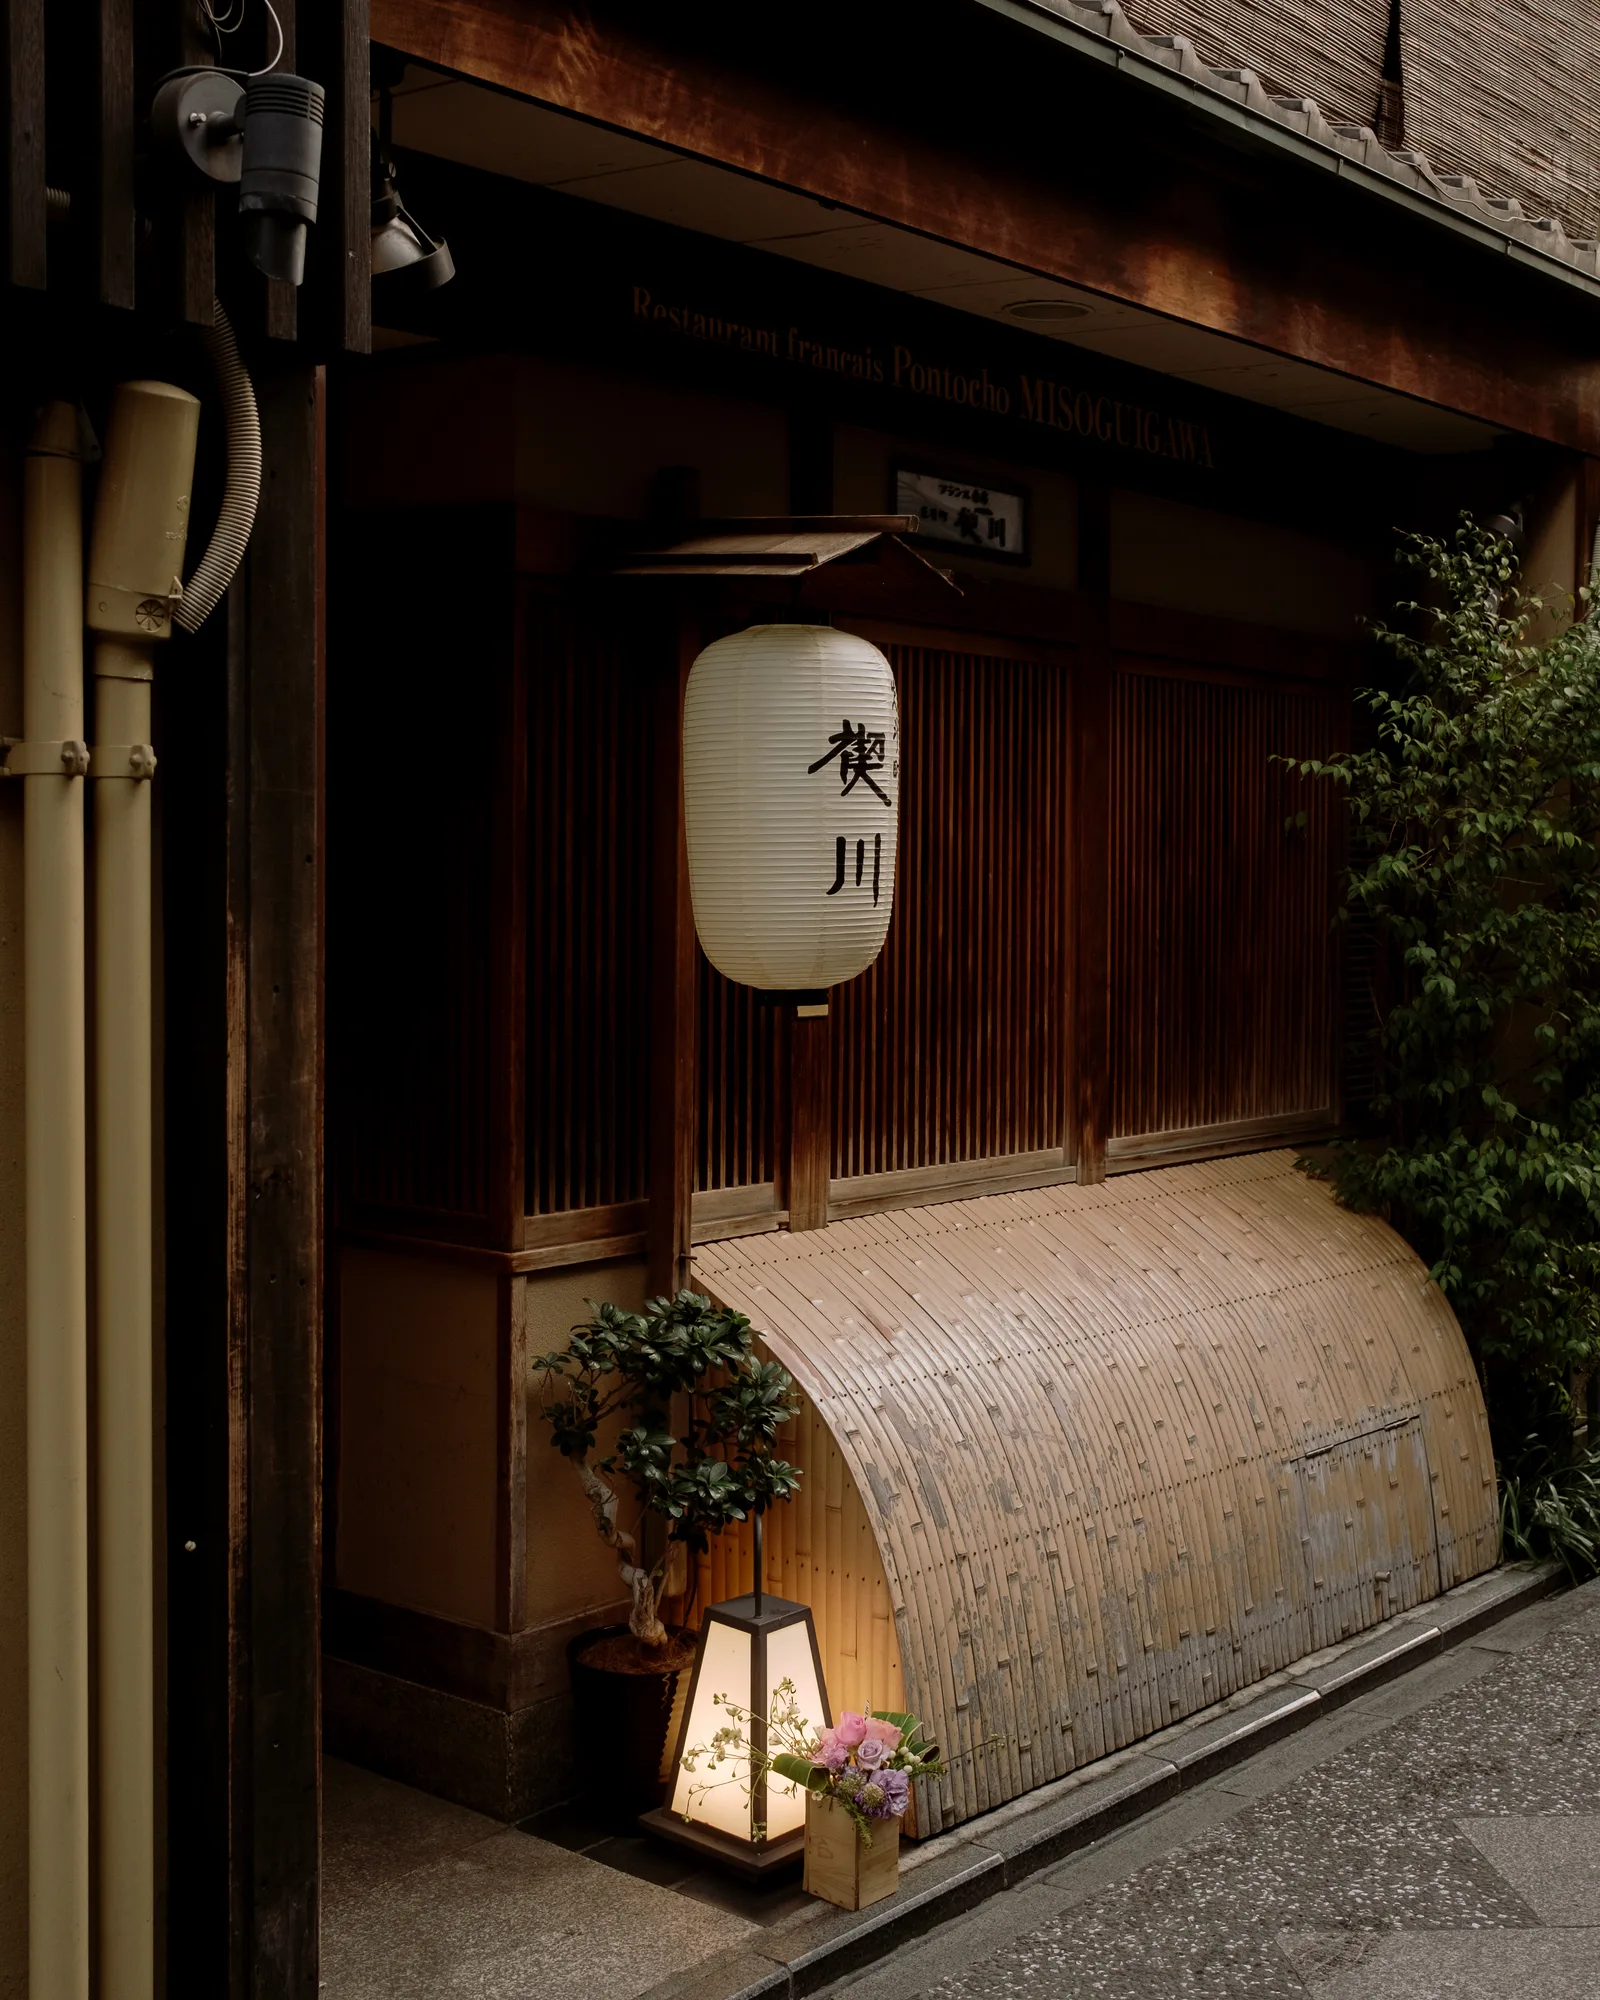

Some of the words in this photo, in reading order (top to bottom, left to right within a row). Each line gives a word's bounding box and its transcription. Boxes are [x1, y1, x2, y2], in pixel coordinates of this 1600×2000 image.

[630, 284, 782, 358] Restaurant
[891, 343, 1012, 415] Pontocho
[1017, 373, 1218, 470] MISOGUIGAWA
